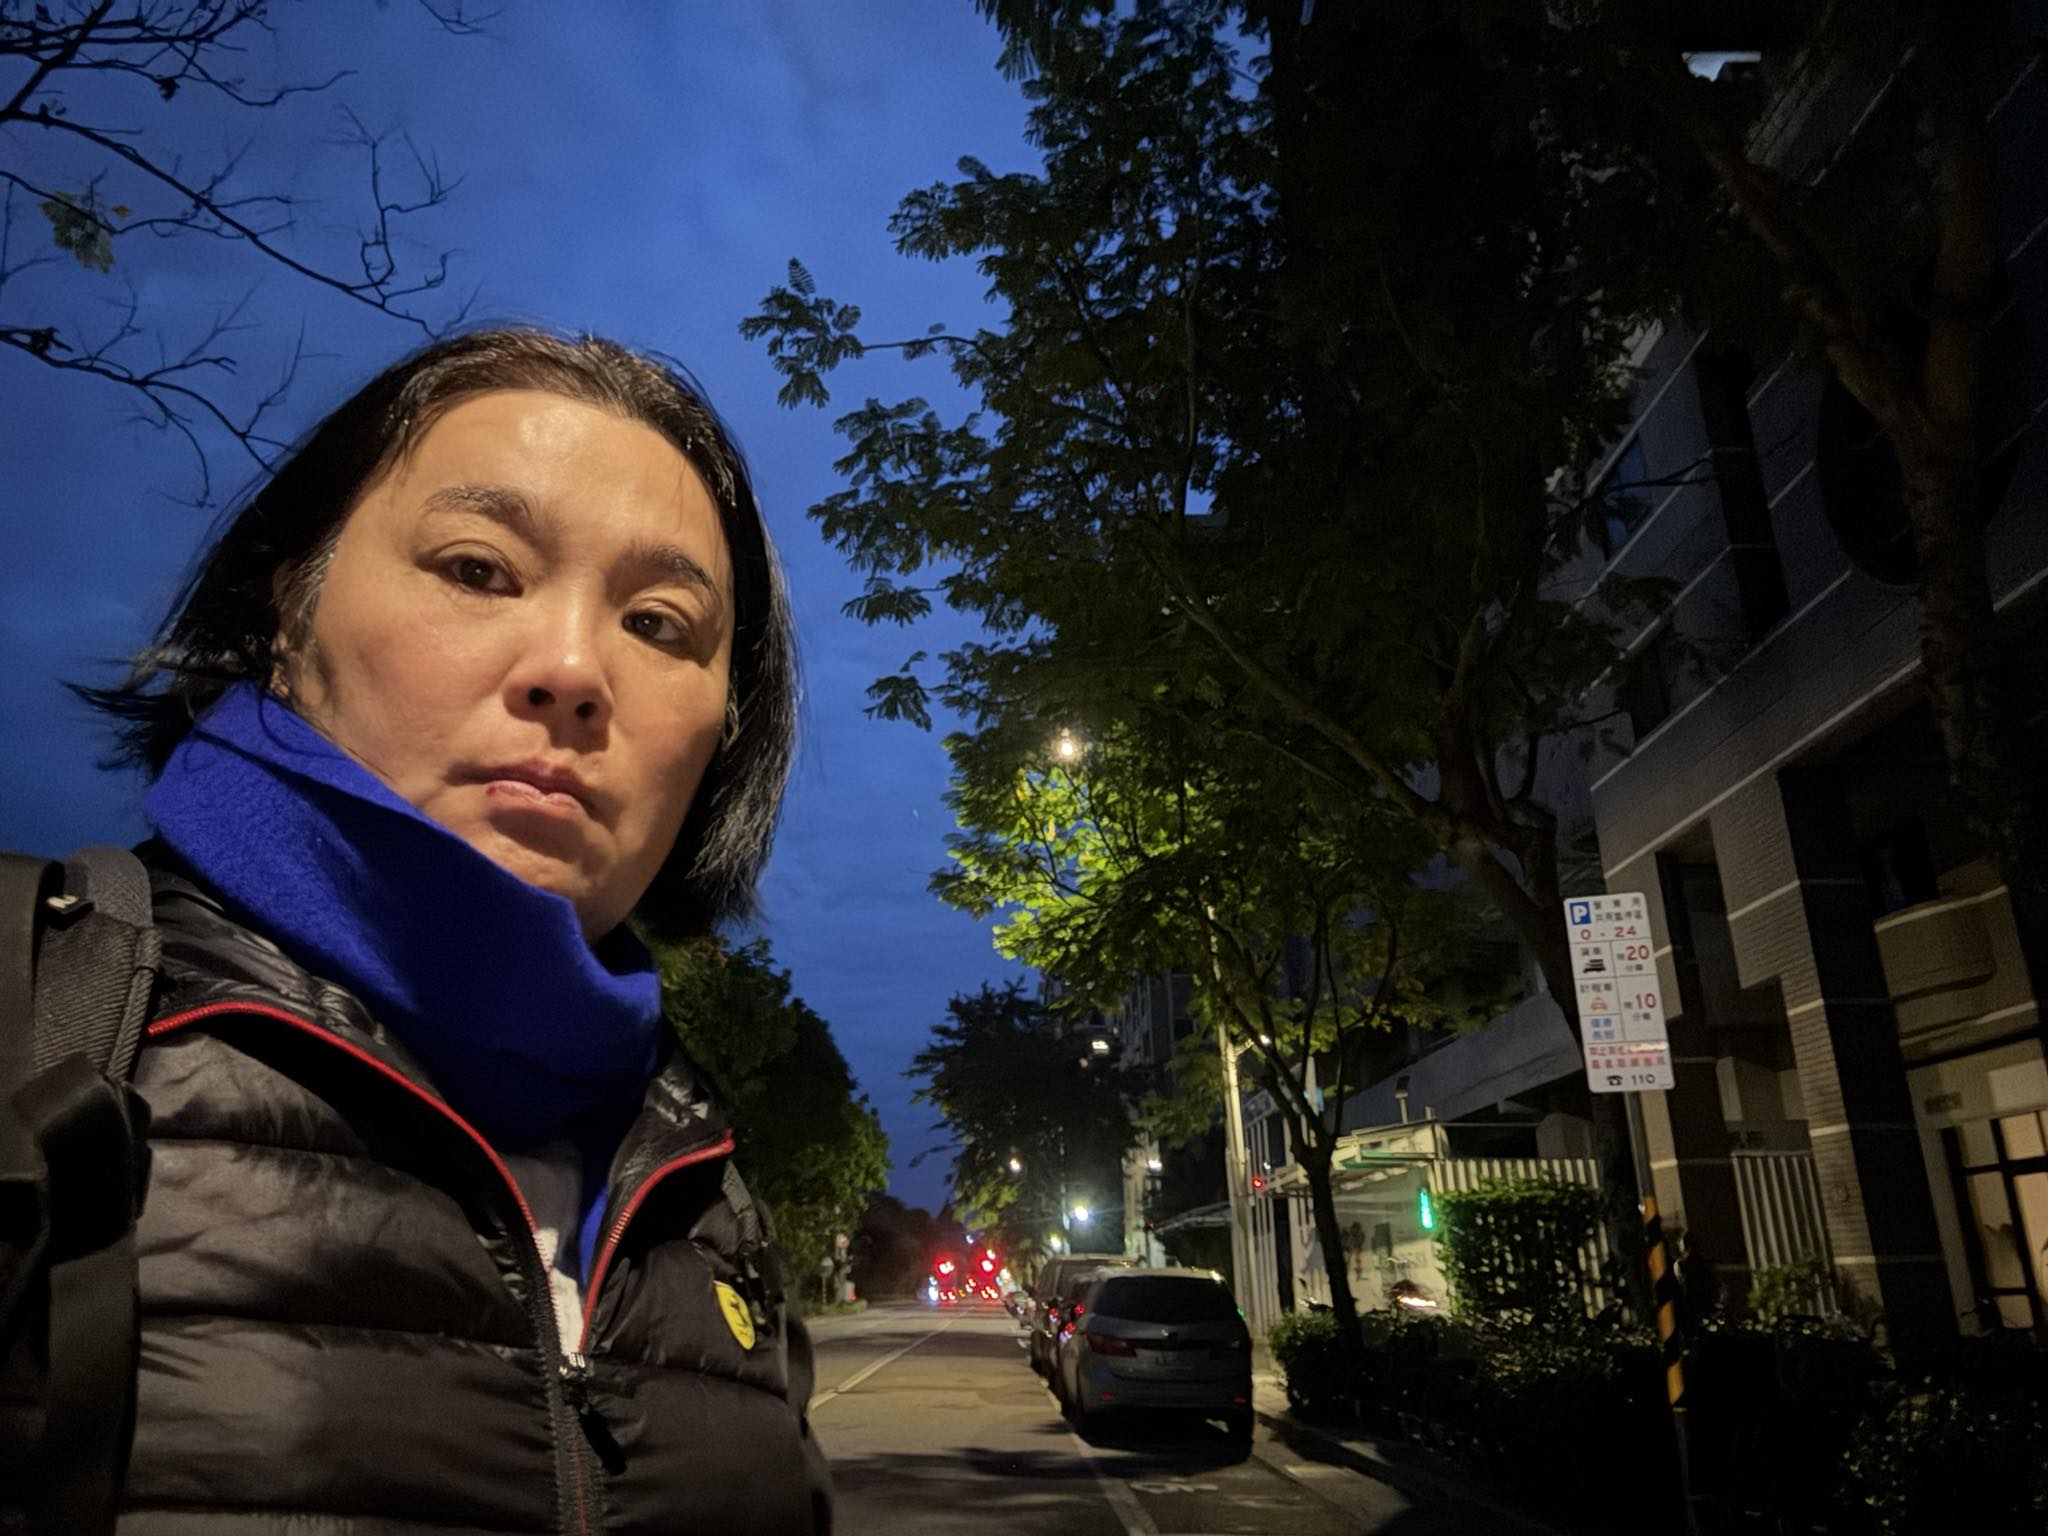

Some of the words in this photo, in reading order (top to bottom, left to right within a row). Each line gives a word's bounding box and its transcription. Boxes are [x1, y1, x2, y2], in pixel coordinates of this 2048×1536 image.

[1614, 926, 1637, 938] 24
[1626, 945, 1650, 961] 20
[1635, 993, 1657, 1009] 10
[1632, 1074, 1656, 1085] 110
